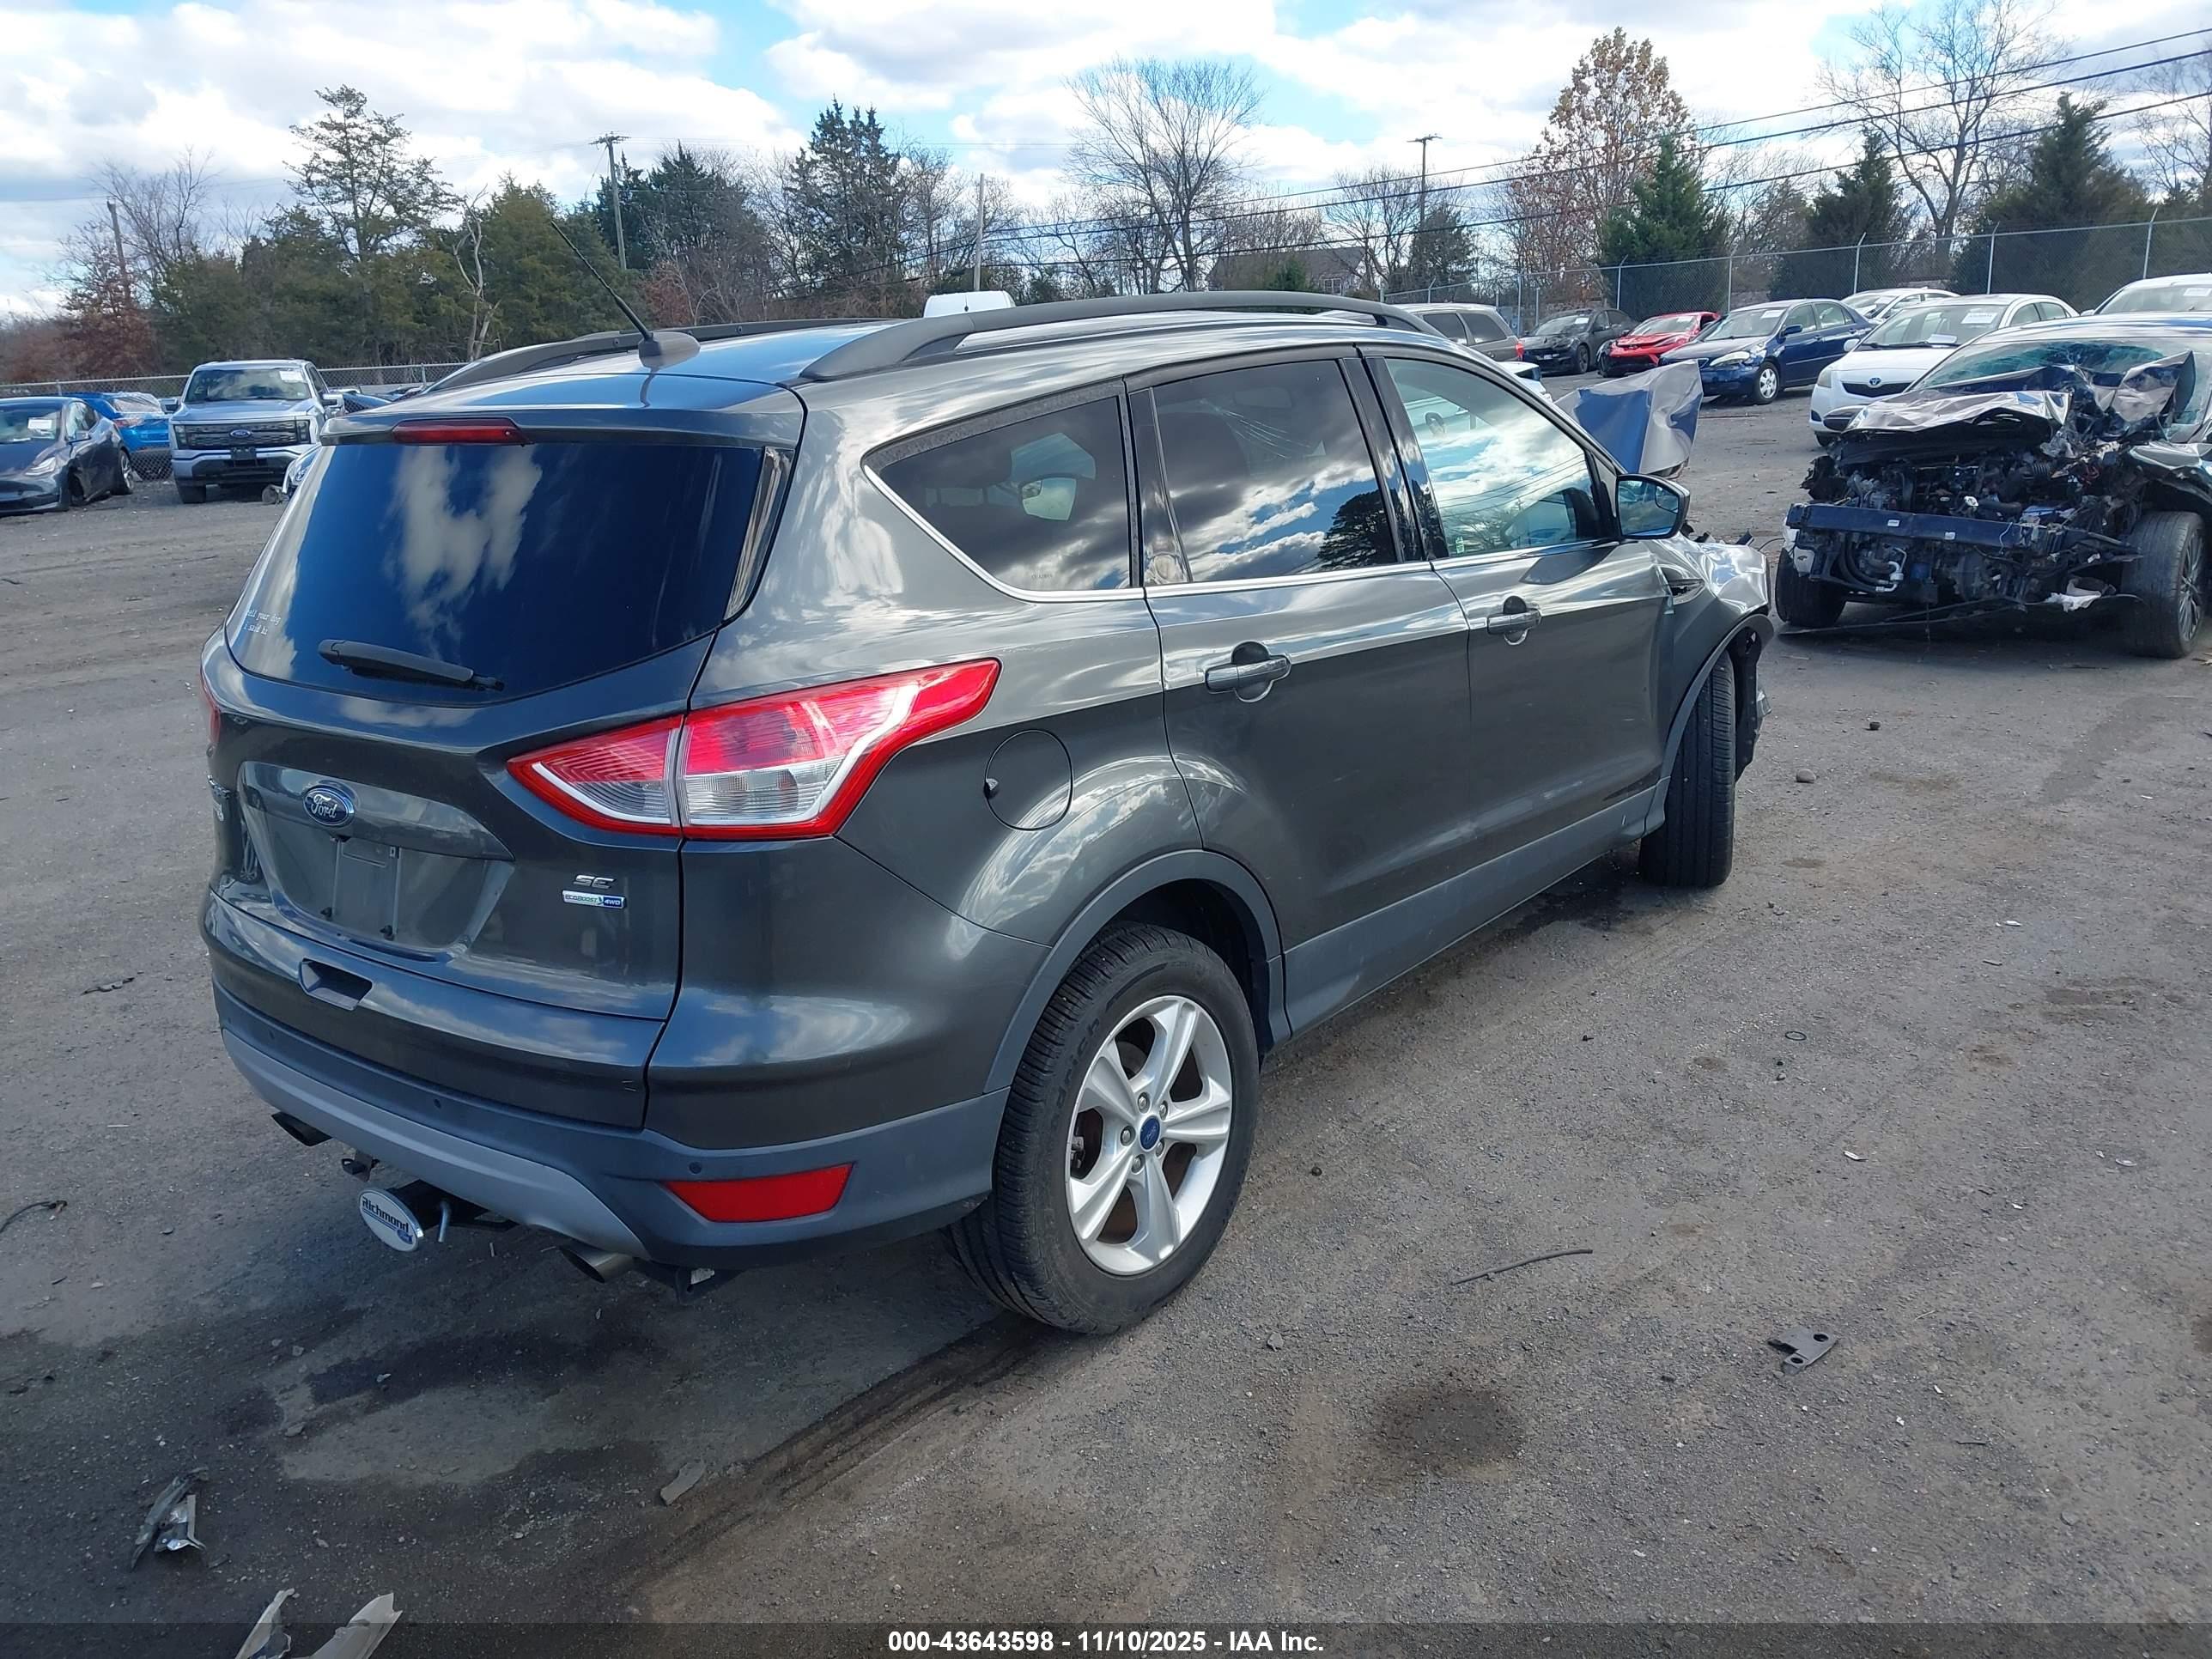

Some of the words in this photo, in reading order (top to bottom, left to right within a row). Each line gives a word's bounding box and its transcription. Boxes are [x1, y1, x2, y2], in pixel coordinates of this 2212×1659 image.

[311, 793, 337, 818] Ford
[573, 874, 615, 889] SE
[362, 1196, 409, 1233] Richmond
